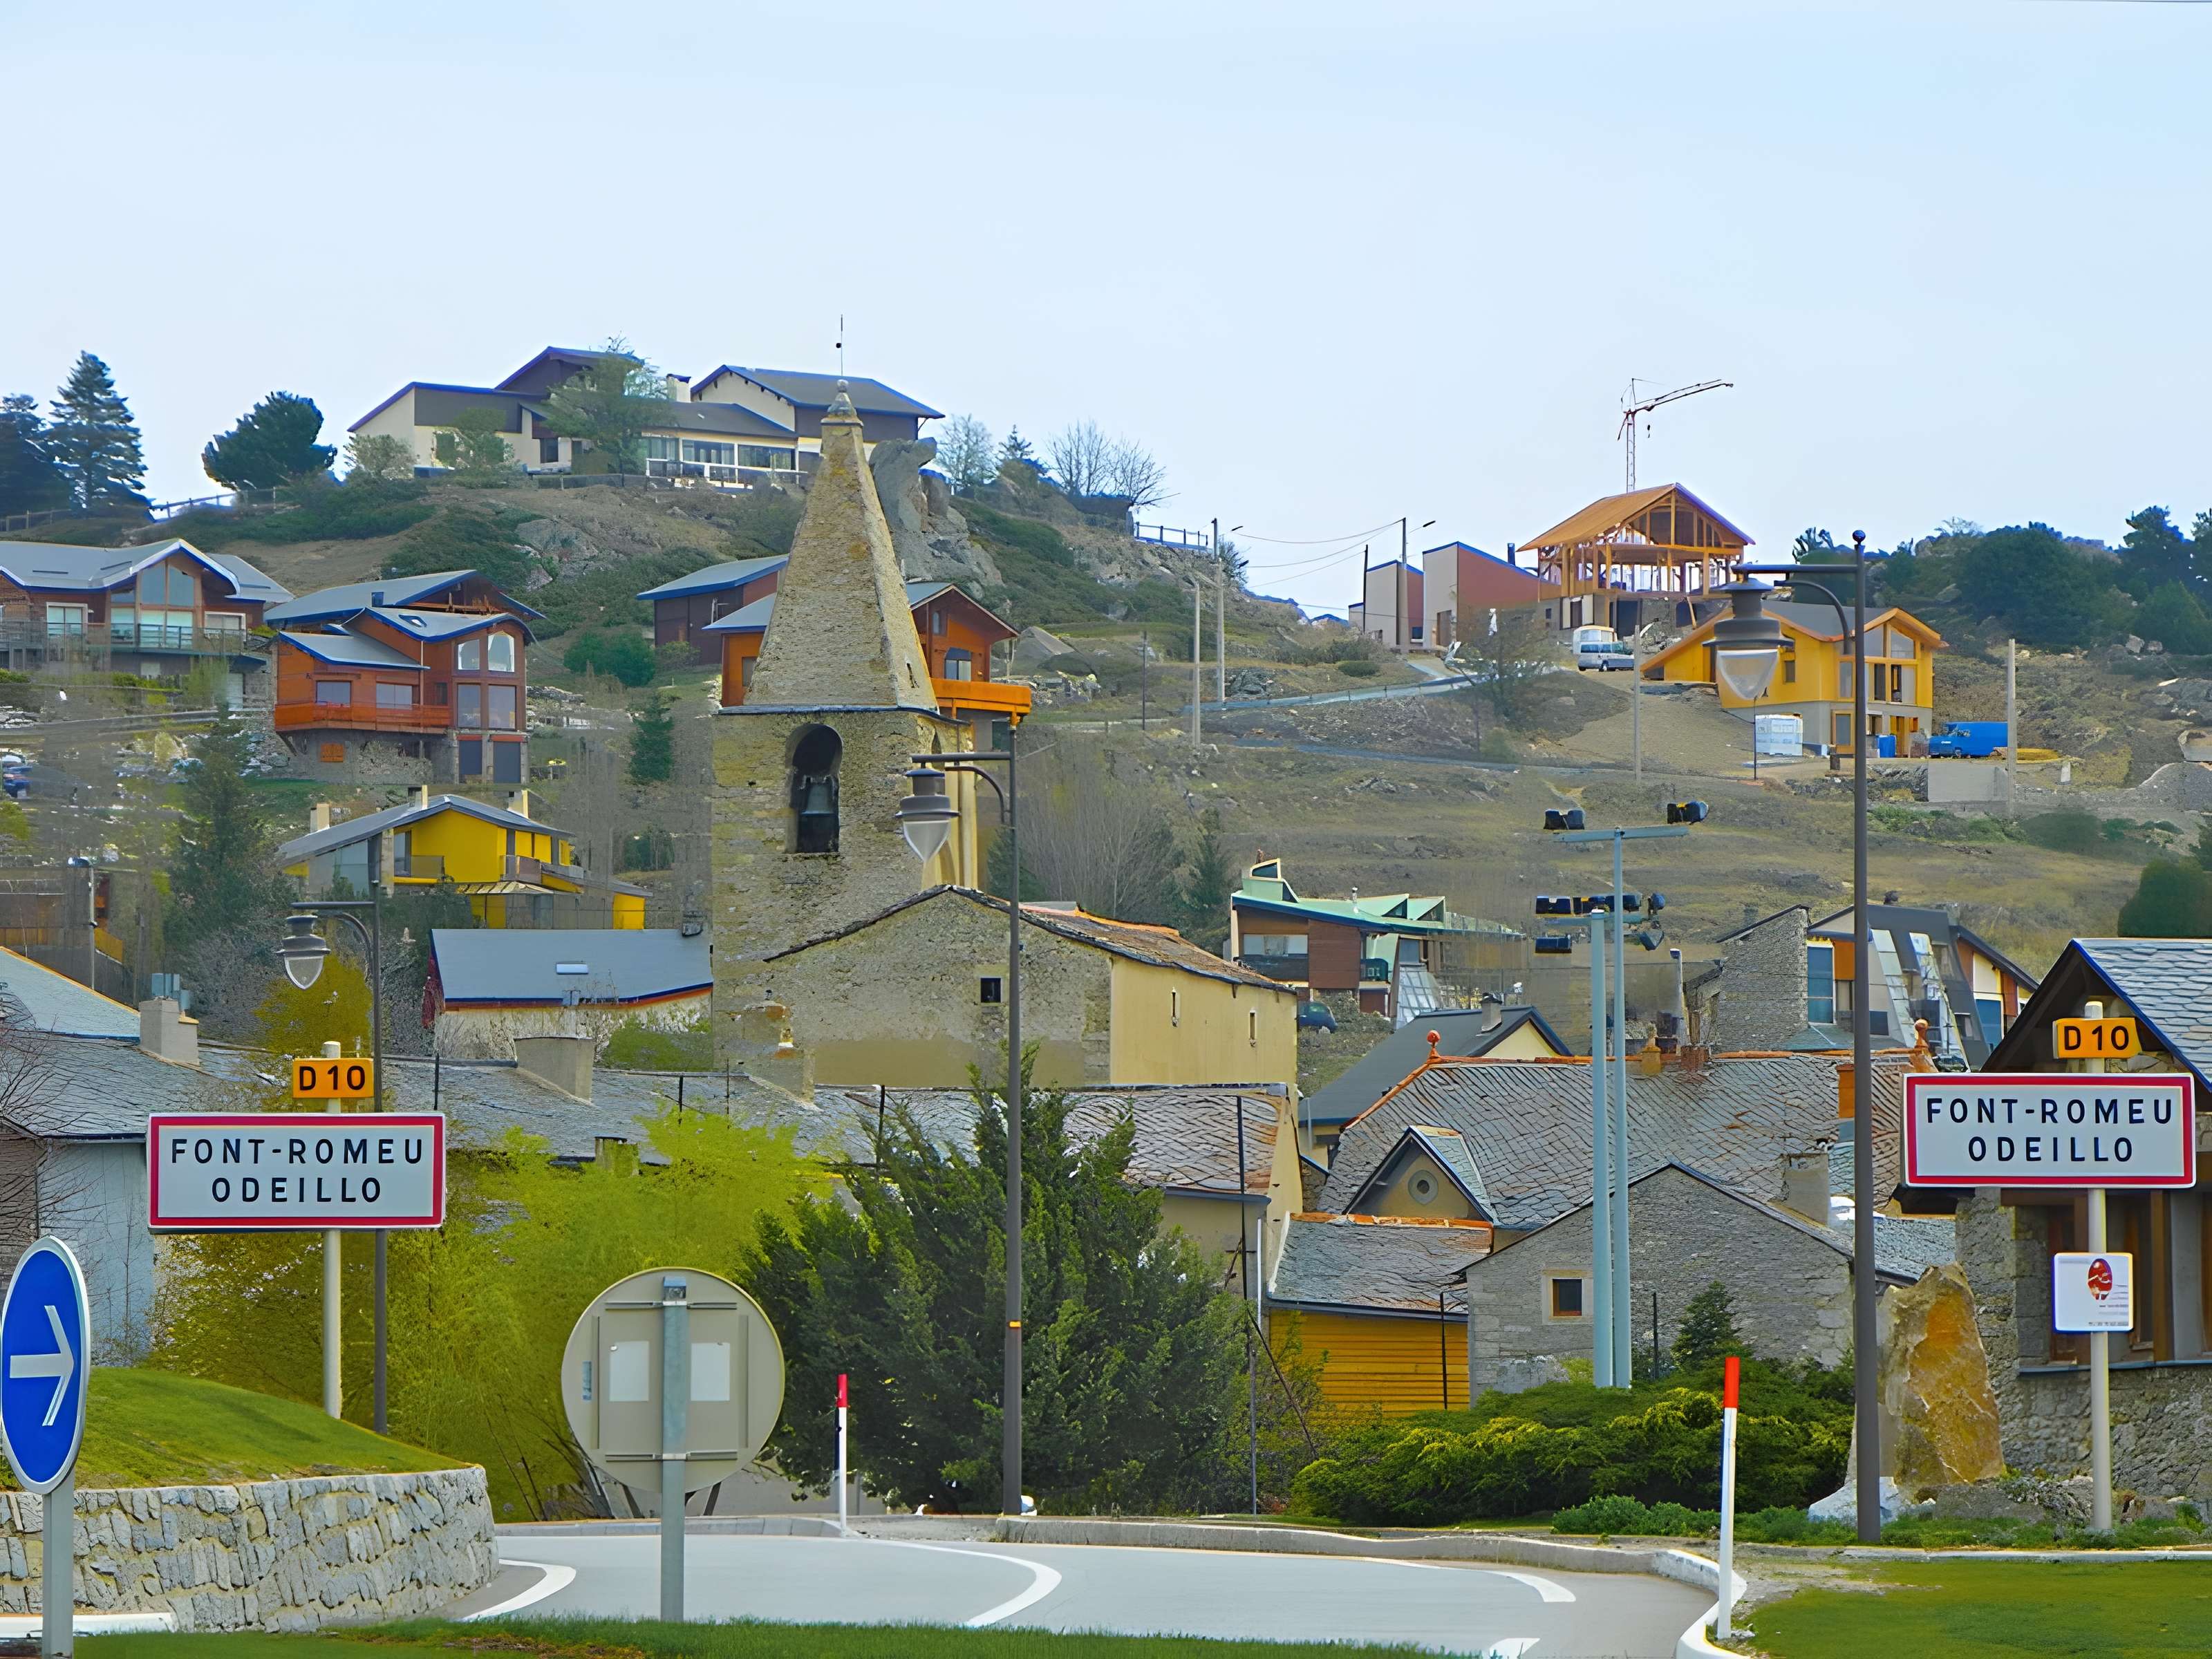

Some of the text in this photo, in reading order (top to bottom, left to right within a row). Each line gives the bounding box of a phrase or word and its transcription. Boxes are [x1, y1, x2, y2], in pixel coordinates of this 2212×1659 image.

[1927, 1098, 2172, 1125] FONT-ROMEU
[171, 1138, 422, 1164] FONT-ROMEU
[1968, 1136, 2133, 1163] ODEILLO
[212, 1177, 381, 1203] ODEILLO
